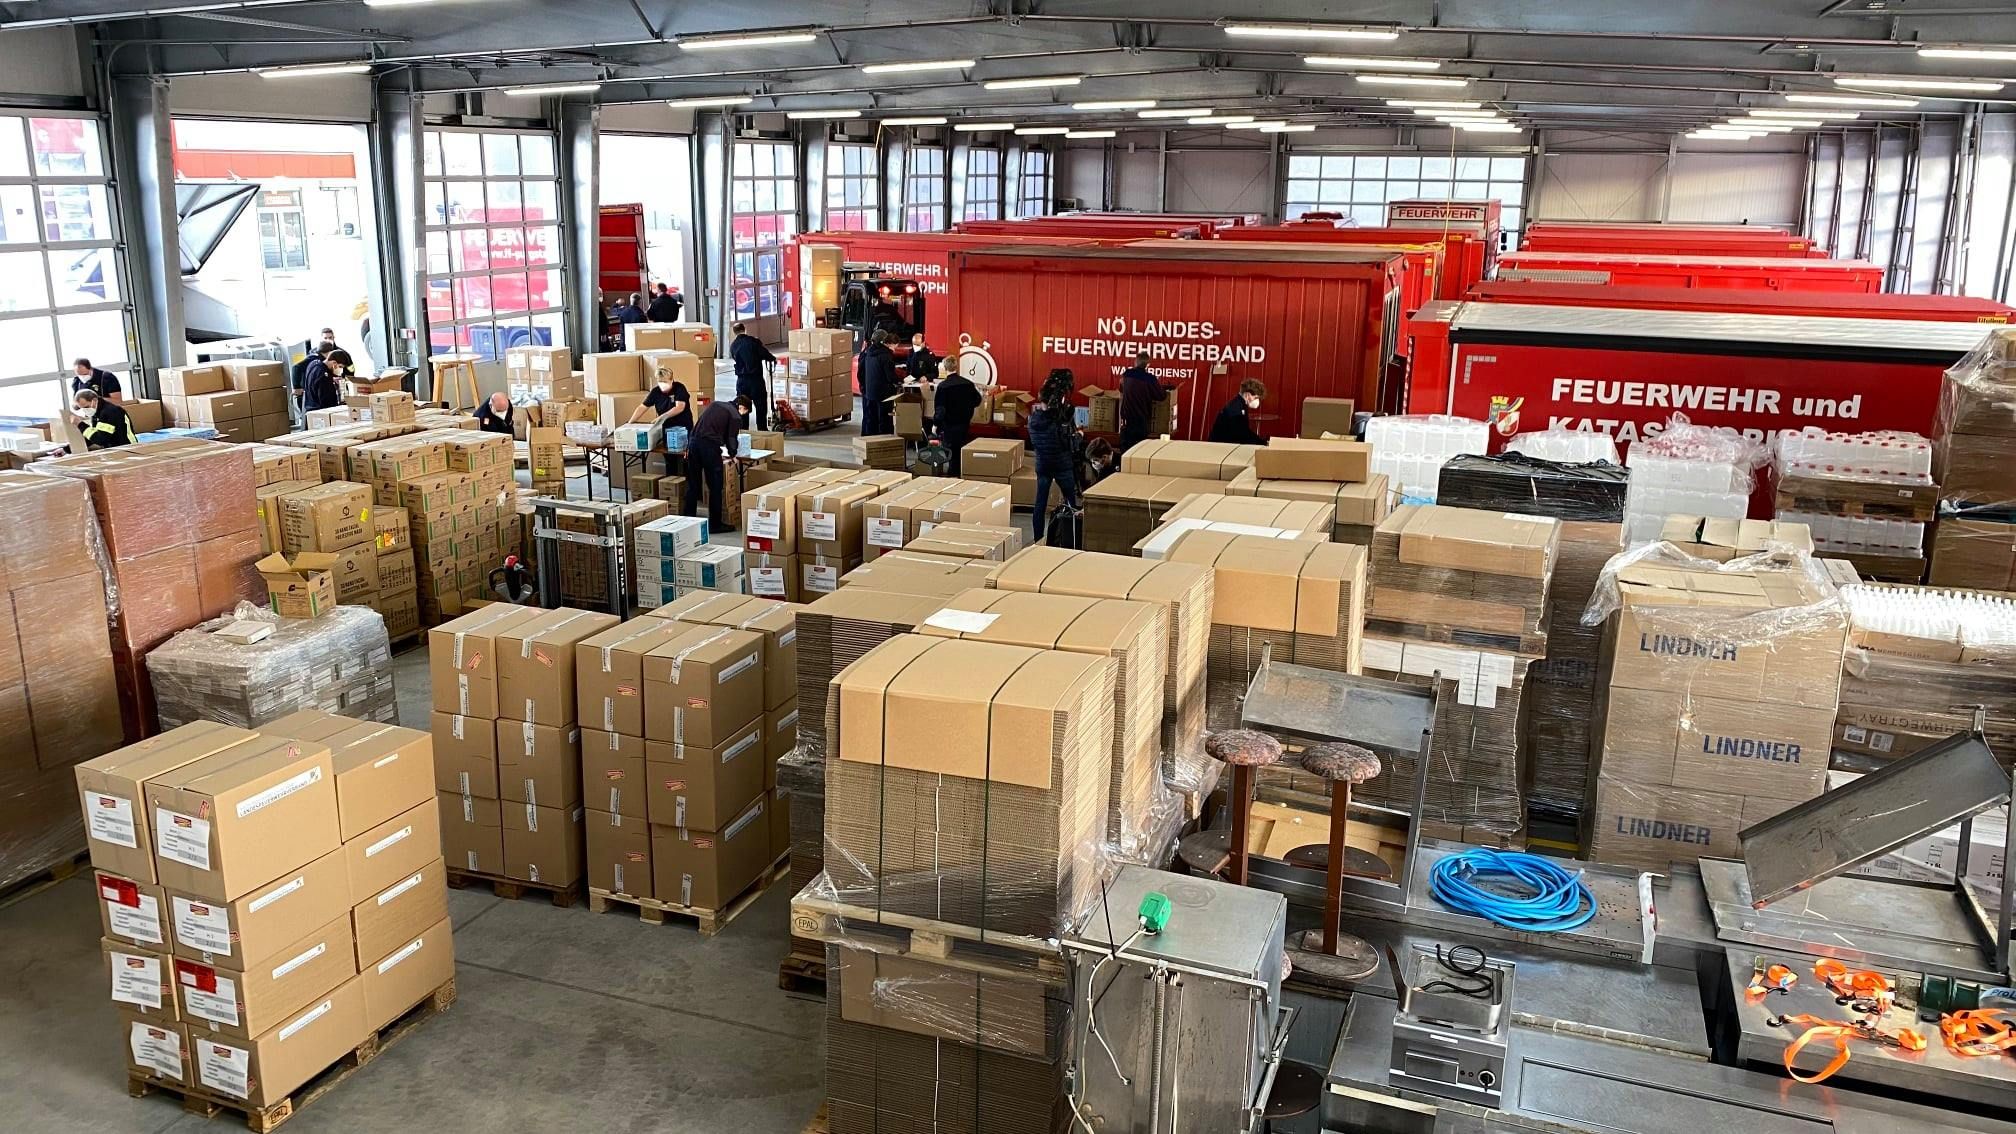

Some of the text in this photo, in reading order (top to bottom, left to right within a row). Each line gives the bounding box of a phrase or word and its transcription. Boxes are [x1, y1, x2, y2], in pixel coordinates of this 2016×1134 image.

[1398, 208, 1477, 219] FEUERWEHR
[1097, 316, 1221, 340] NÖ LANDES-
[1041, 336, 1266, 364] FEUERWEHRVERBAND
[1551, 377, 1862, 420] FEUERWEHR und
[1639, 632, 1738, 662] LINDNER
[1702, 734, 1801, 764] LINDNER
[1616, 814, 1712, 847] LINDNER
[798, 919, 815, 929] EPAL
